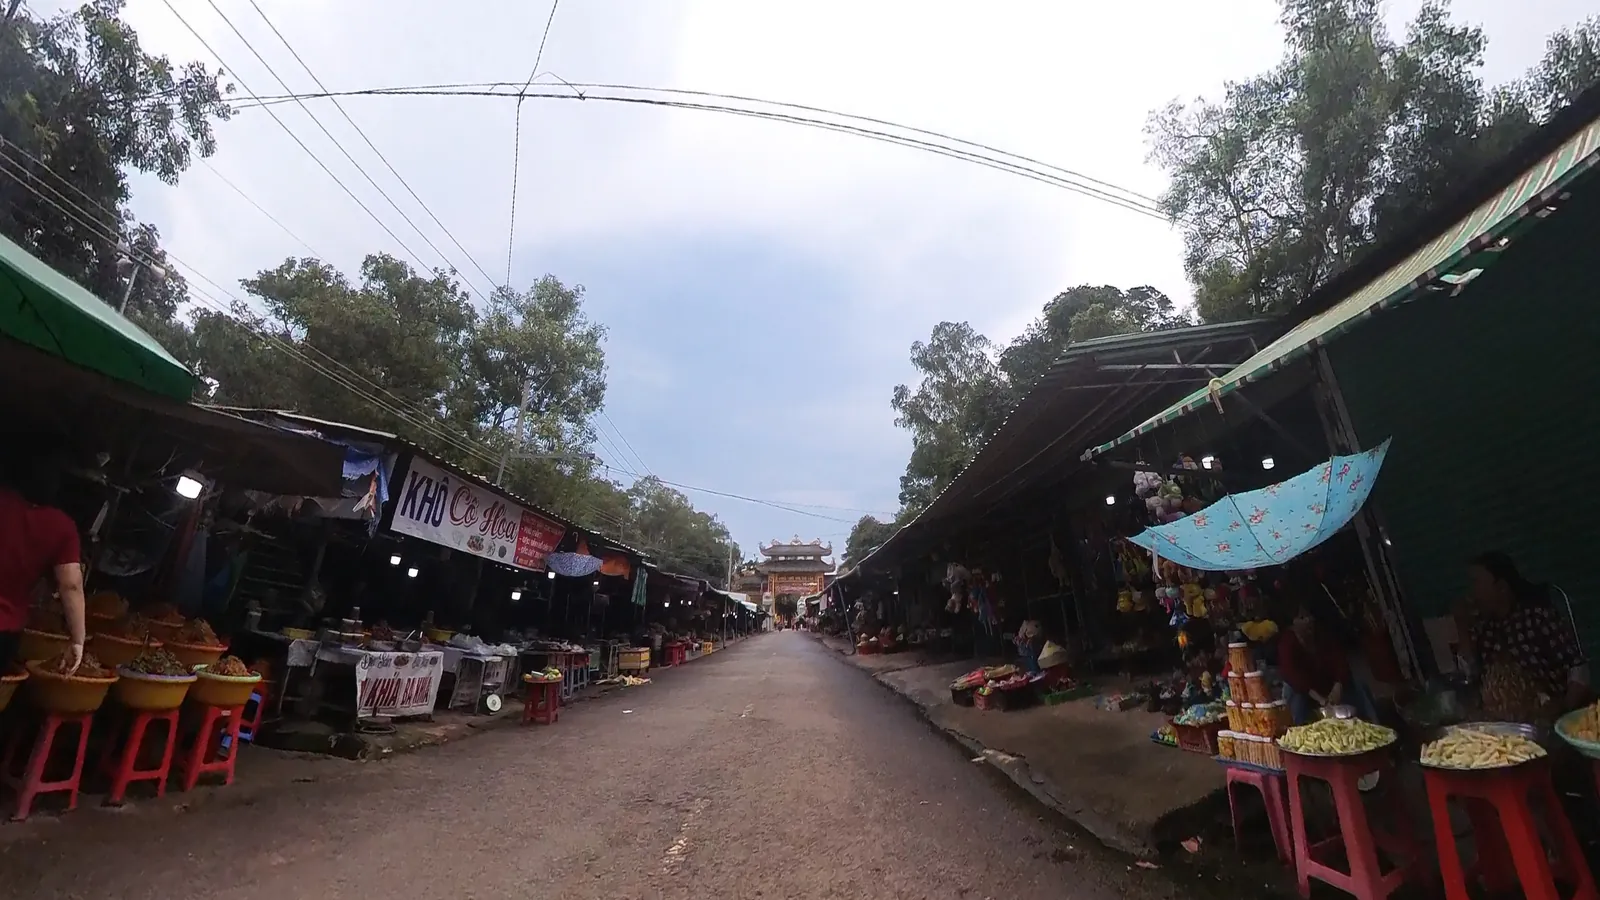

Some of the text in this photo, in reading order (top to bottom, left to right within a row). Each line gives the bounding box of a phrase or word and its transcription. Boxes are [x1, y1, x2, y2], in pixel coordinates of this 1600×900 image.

[400, 471, 449, 527] KHÔ
[449, 485, 479, 527] Cô
[479, 500, 519, 543] Hoa
